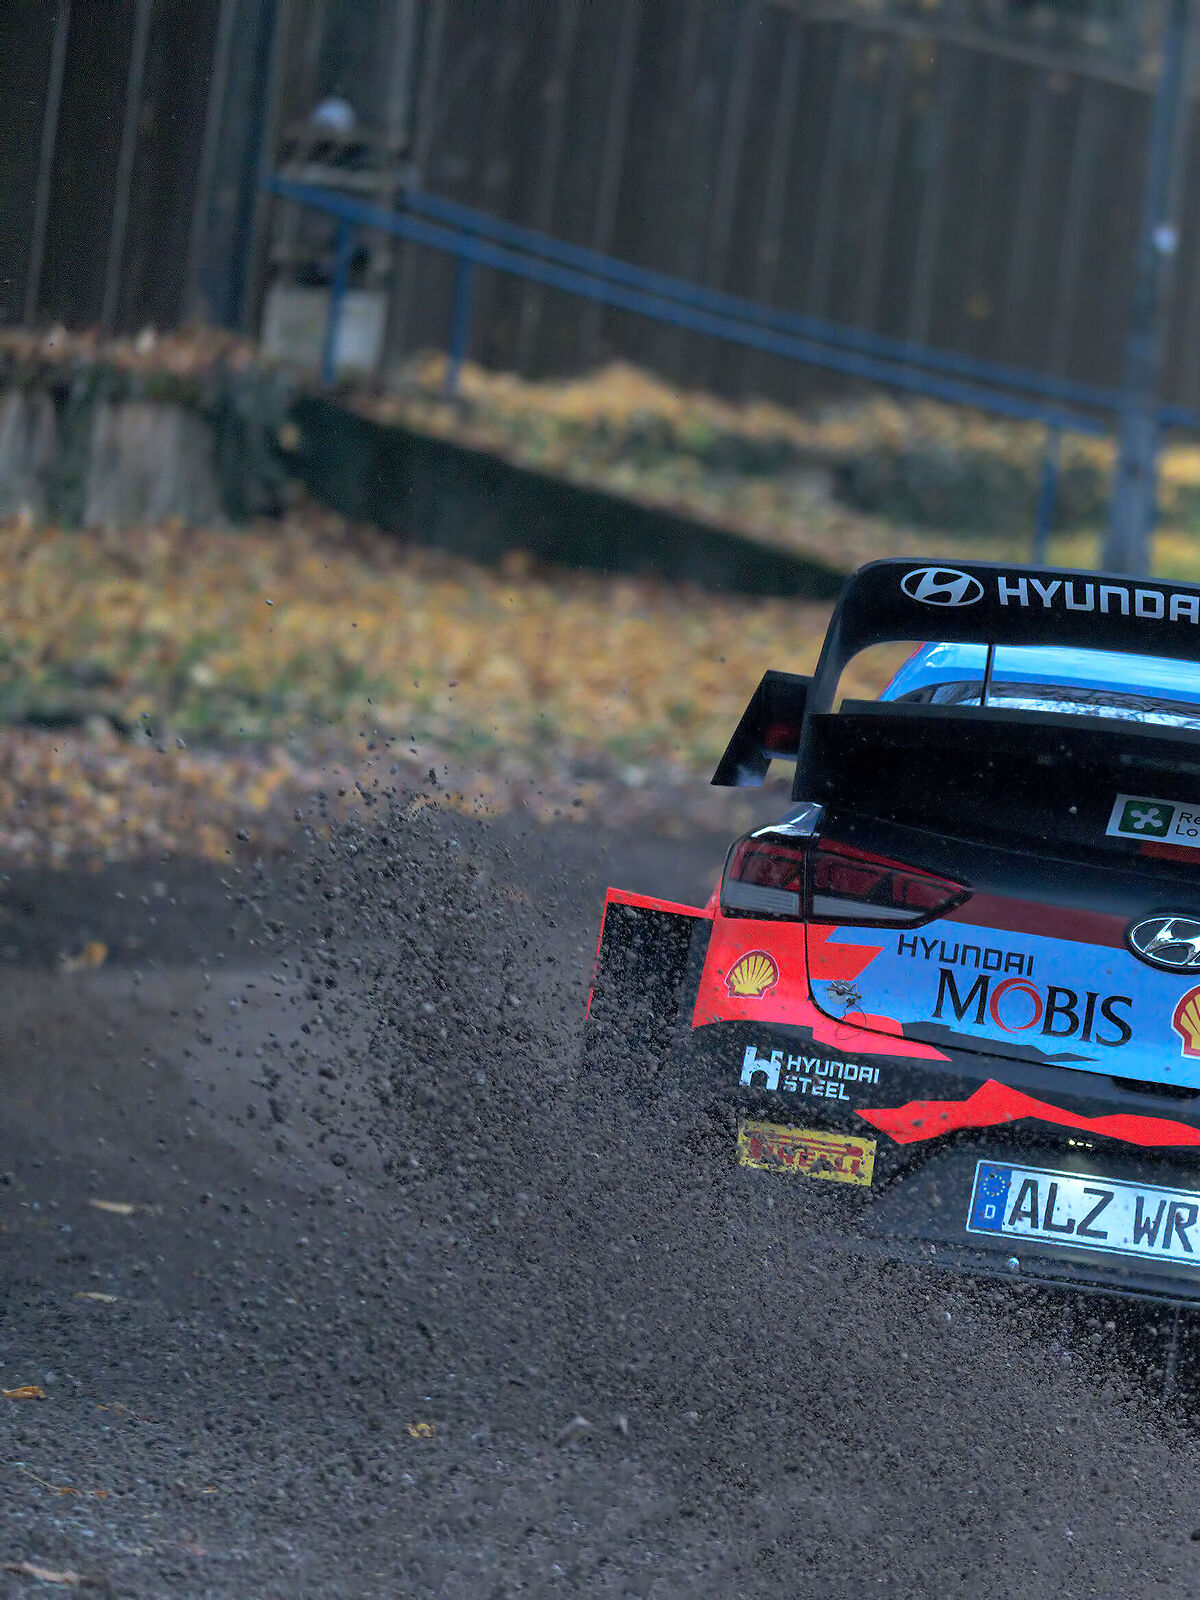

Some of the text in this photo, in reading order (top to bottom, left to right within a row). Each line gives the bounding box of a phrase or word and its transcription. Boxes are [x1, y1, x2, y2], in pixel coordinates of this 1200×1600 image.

[897, 933, 1034, 977] HYUNDAI
[931, 967, 1134, 1048] MOBIS
[782, 1074, 850, 1101] STEEL
[787, 1054, 880, 1085] HYUNDAI
[984, 1204, 996, 1221] D
[1008, 1178, 1115, 1241] ALZ
[1132, 1195, 1199, 1253] WR
